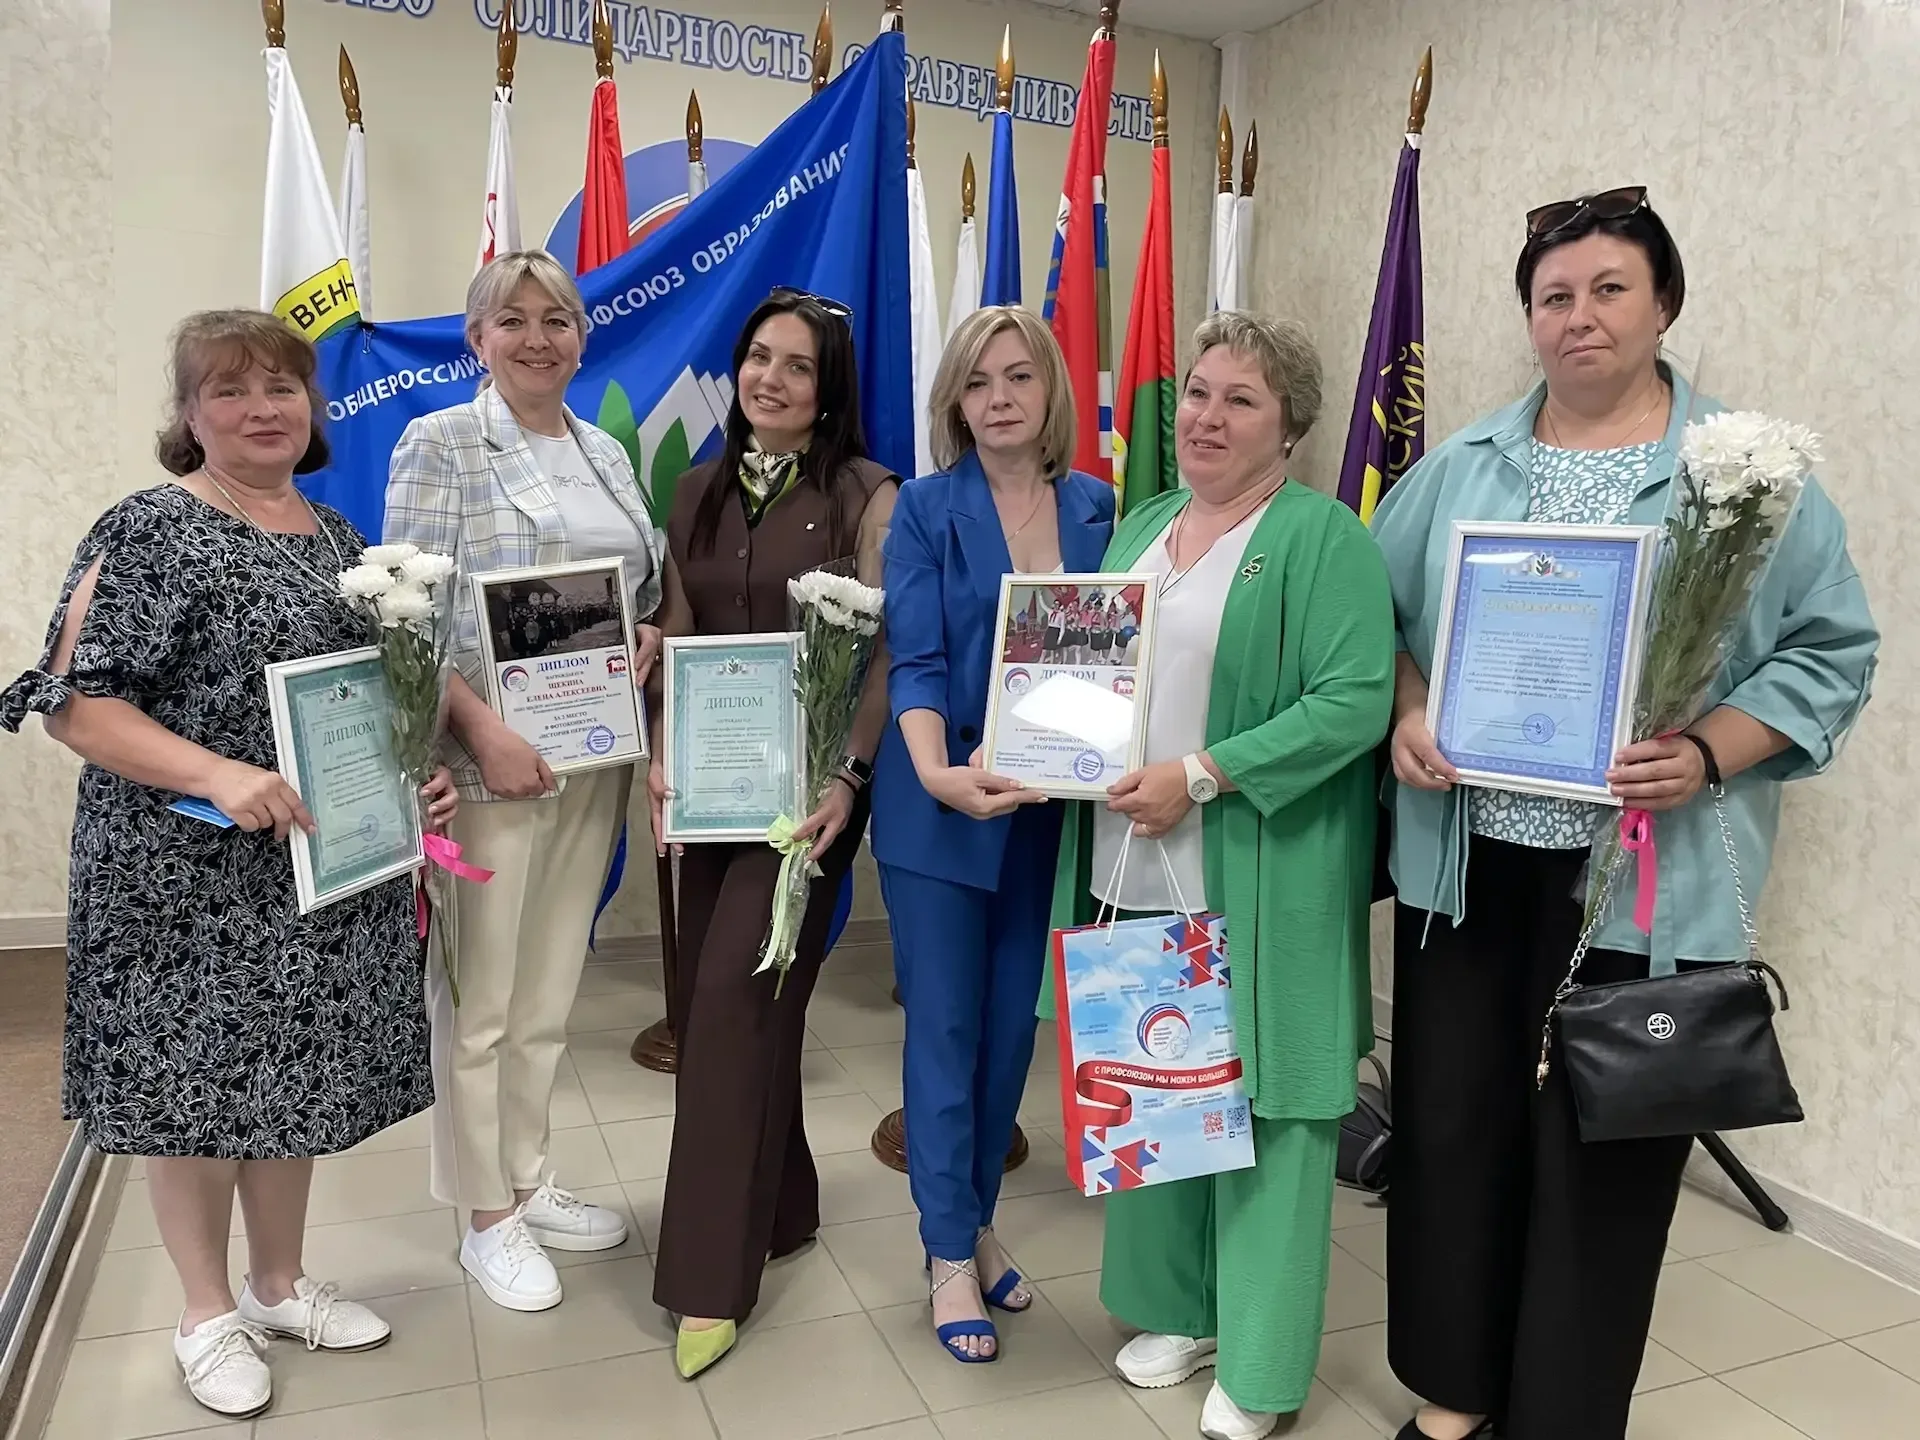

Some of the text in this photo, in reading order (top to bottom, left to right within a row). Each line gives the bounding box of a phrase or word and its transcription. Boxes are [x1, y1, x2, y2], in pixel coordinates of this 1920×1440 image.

[843, 44, 1155, 142] РАВЕДЛИВТЬ
[1389, 342, 1424, 481] СКИЙ
[536, 656, 590, 674] ДИПЛОМ
[1040, 669, 1096, 681] ДИОМ
[704, 696, 763, 711] ДИПЛОМ
[323, 720, 376, 747] ДИПЛОМ
[1094, 1066, 1099, 1074] С
[1101, 1066, 1154, 1082] ПРОФСОЮЗОМ
[1156, 1075, 1169, 1083] МЫ
[1170, 1075, 1197, 1084] МОЖЕМ
